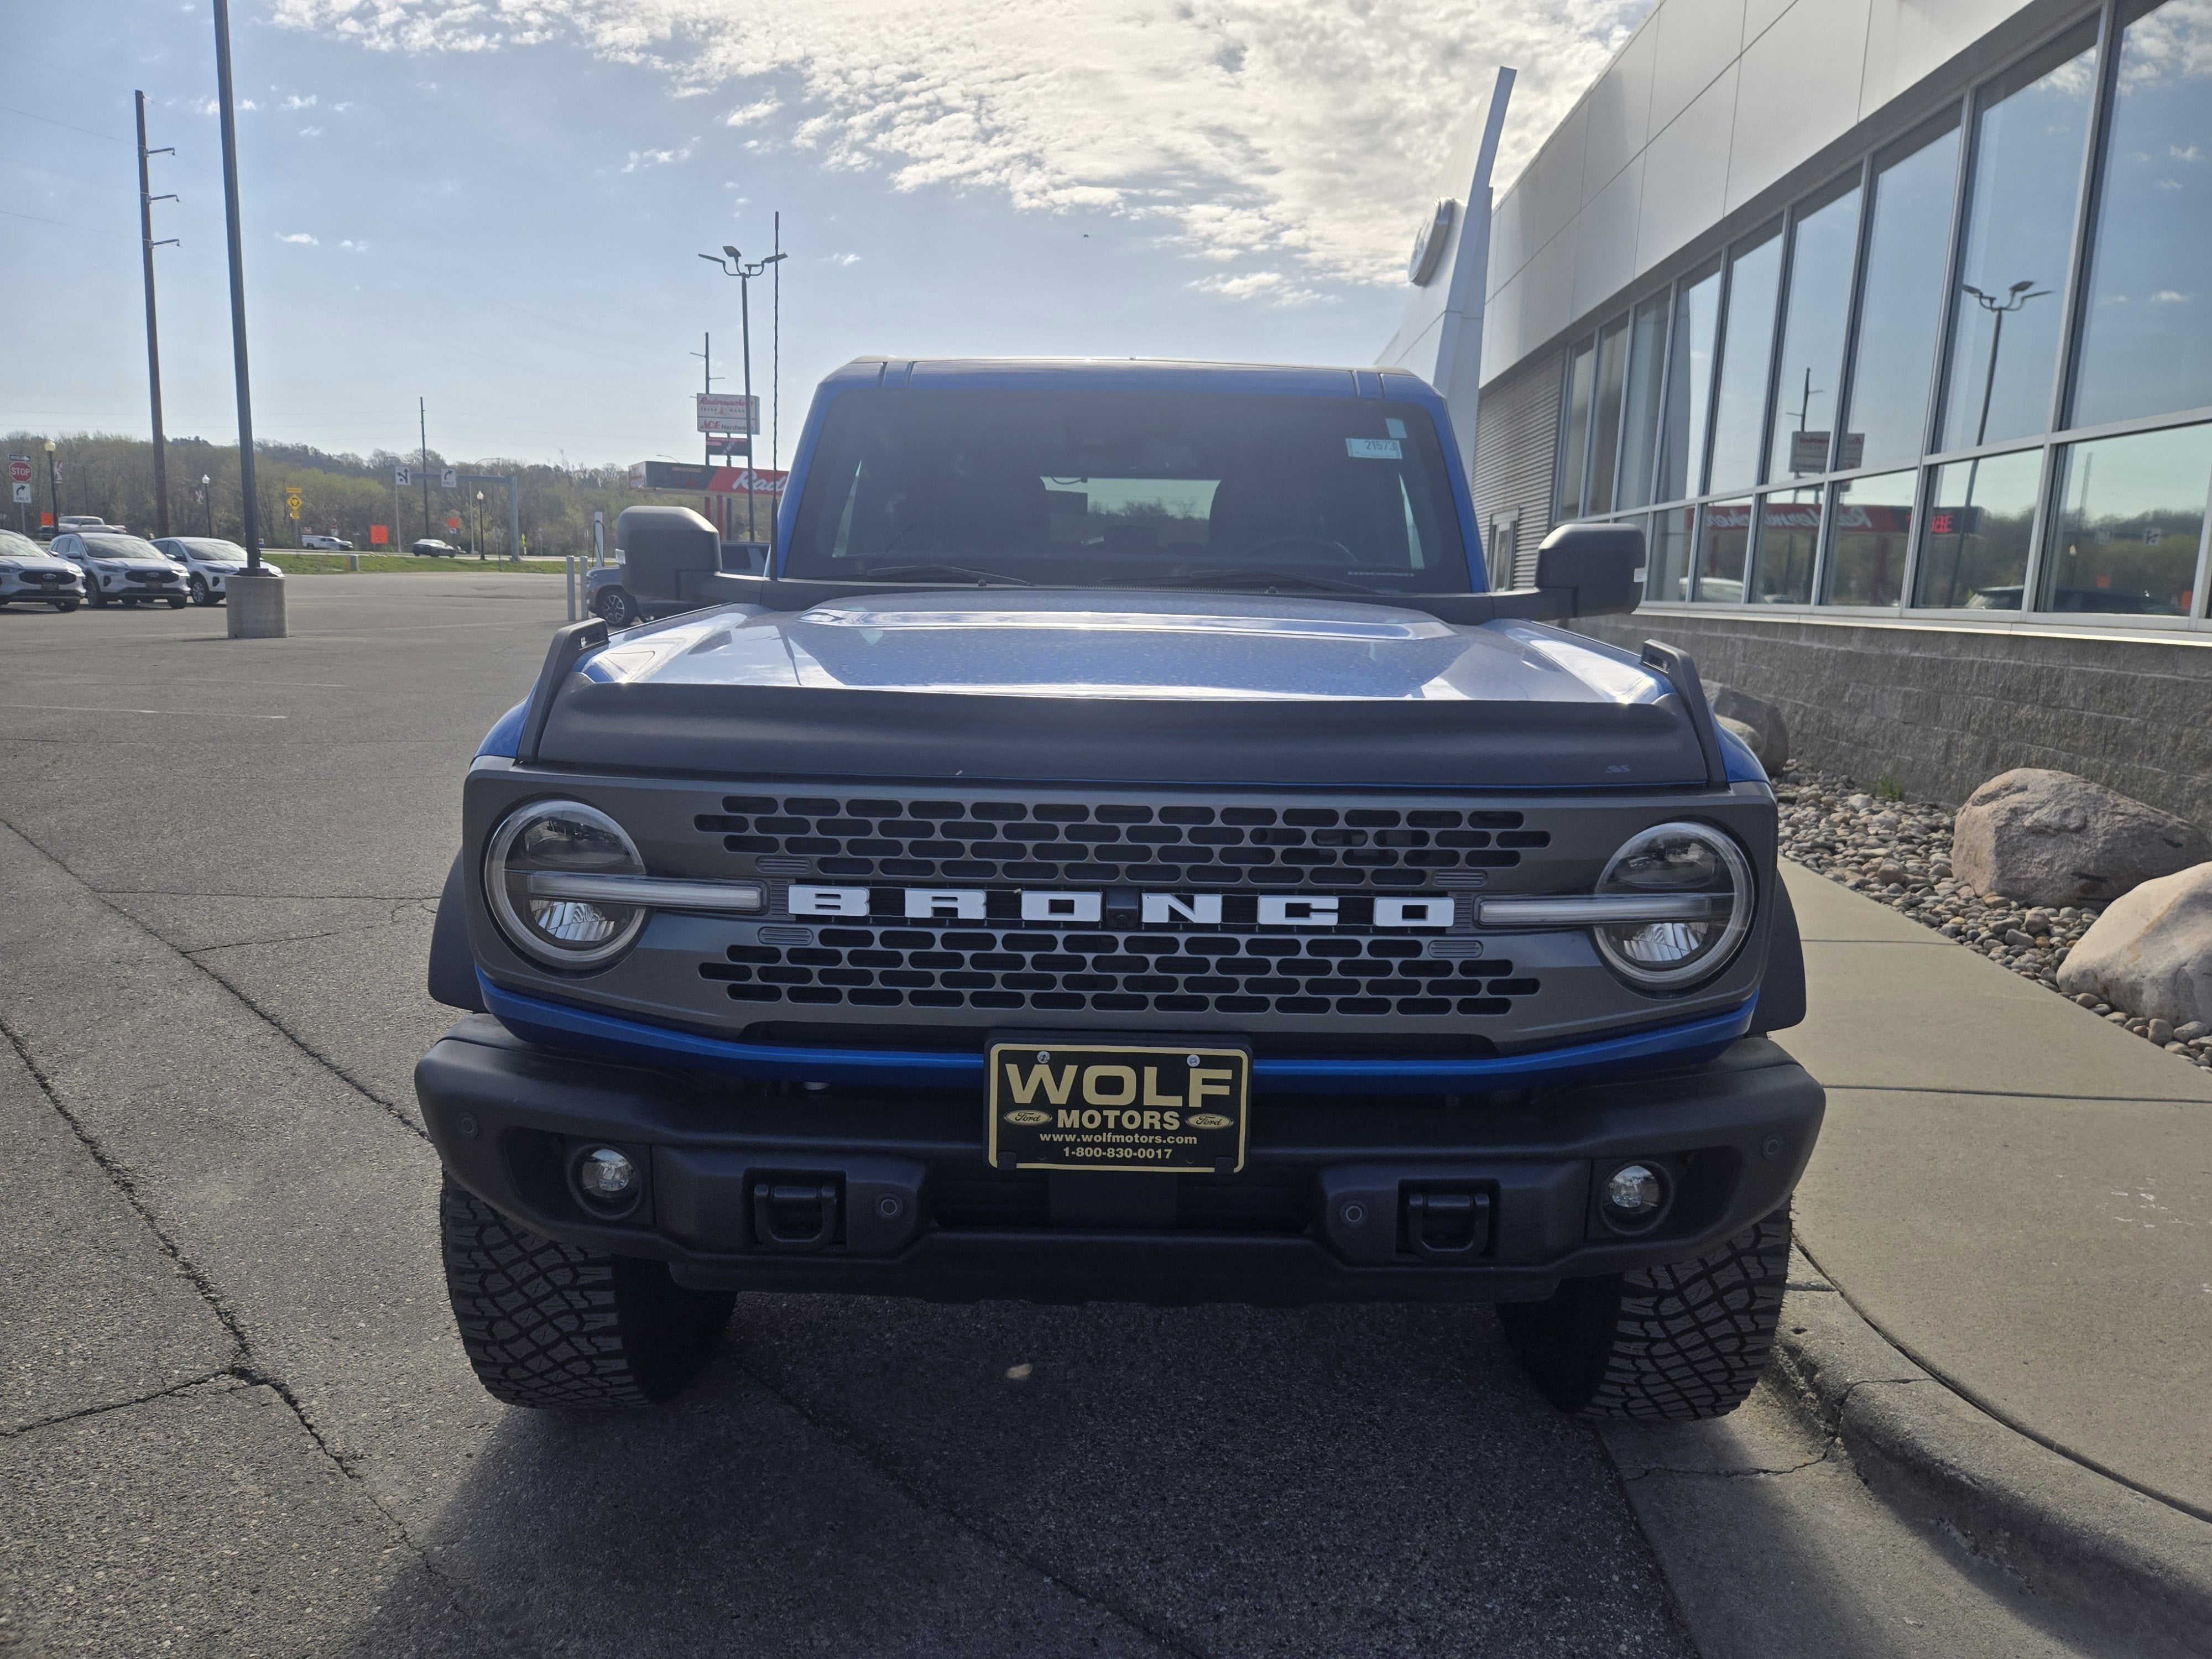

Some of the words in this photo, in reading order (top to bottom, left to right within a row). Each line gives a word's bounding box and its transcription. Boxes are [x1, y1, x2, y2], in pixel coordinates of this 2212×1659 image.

[701, 420, 721, 429] ACE
[11, 467, 30, 476] STOP
[789, 886, 1455, 927] BRONCO
[1005, 1063, 1233, 1107] WOLF
[1015, 1112, 1041, 1121] Ford
[1057, 1109, 1180, 1130] MOTORS
[1196, 1116, 1222, 1125] Ford
[1040, 1133, 1197, 1145] www.wolfmotors.com
[1063, 1147, 1172, 1159] 1-800-830-0017
